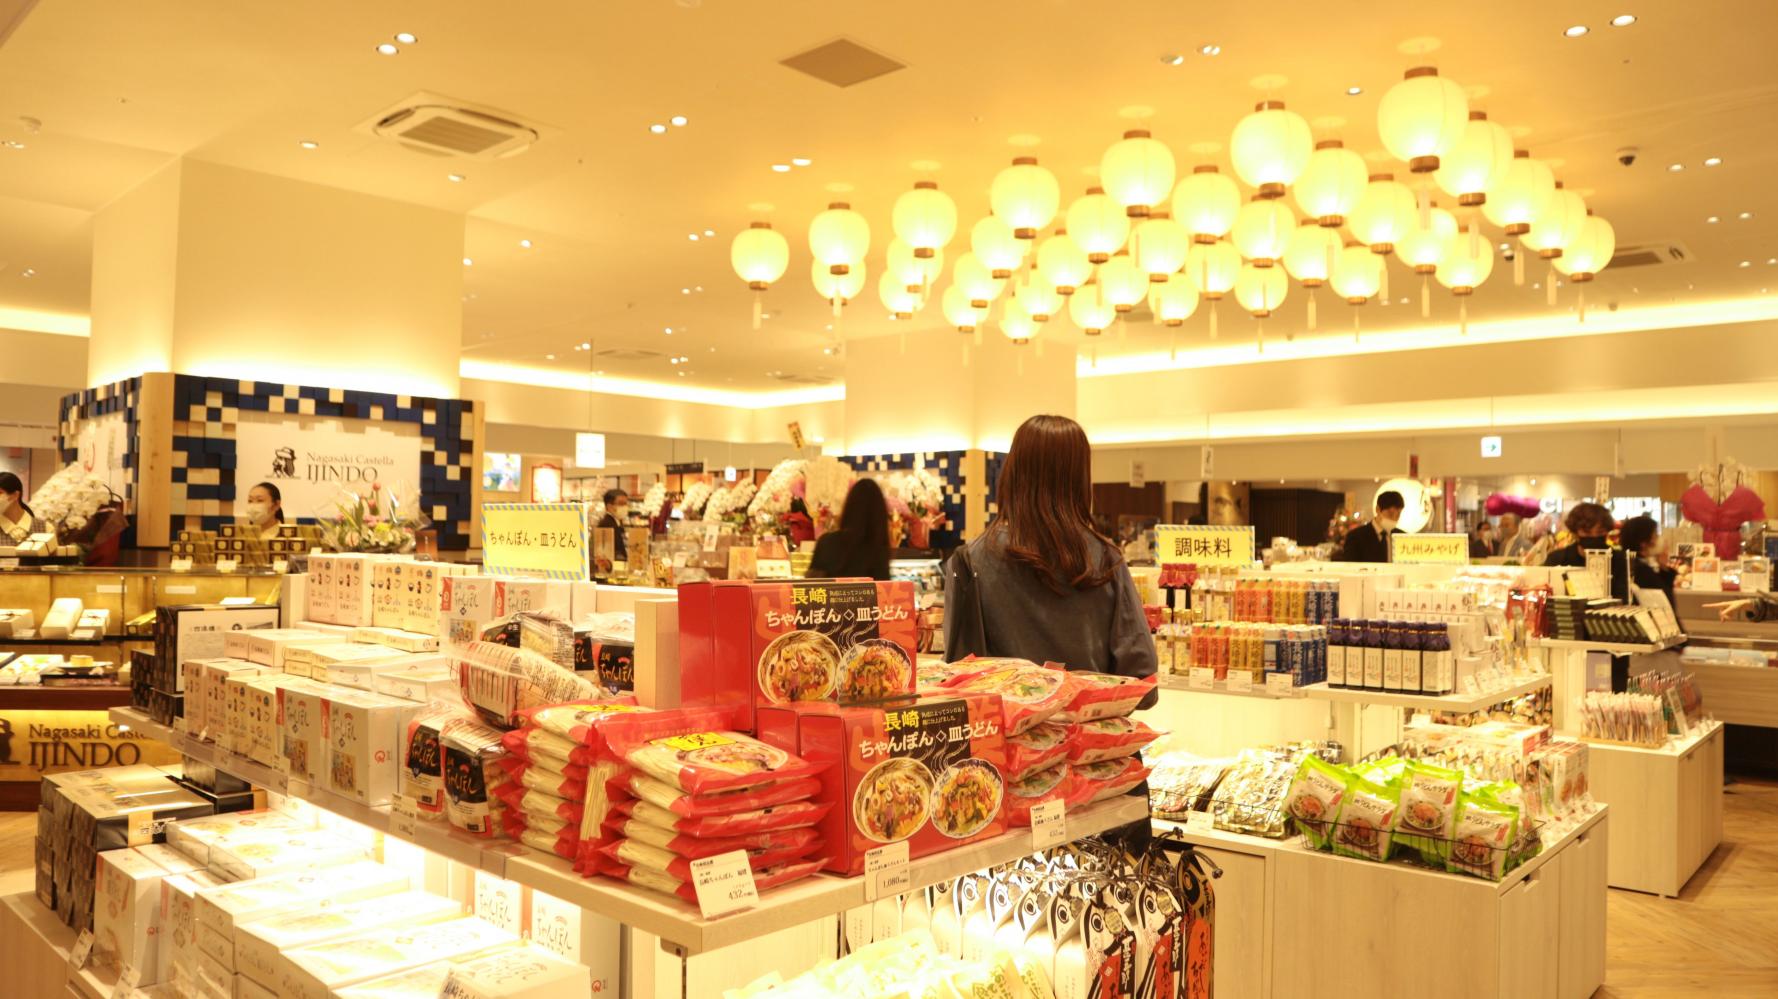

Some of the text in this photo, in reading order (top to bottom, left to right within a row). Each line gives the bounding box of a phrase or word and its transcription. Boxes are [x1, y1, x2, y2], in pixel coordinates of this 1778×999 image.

[306, 452, 394, 466] Nagasaki Castella
[307, 464, 378, 485] IJINDO
[490, 530, 577, 548] ちゃんぽん・皿うどん
[1175, 537, 1232, 558] 調味料
[1400, 543, 1460, 555] 九州みやげ
[790, 587, 828, 605] 長崎
[883, 710, 919, 732] 長崎
[29, 724, 101, 741] Nagasaki
[28, 741, 141, 772] IJINDO
